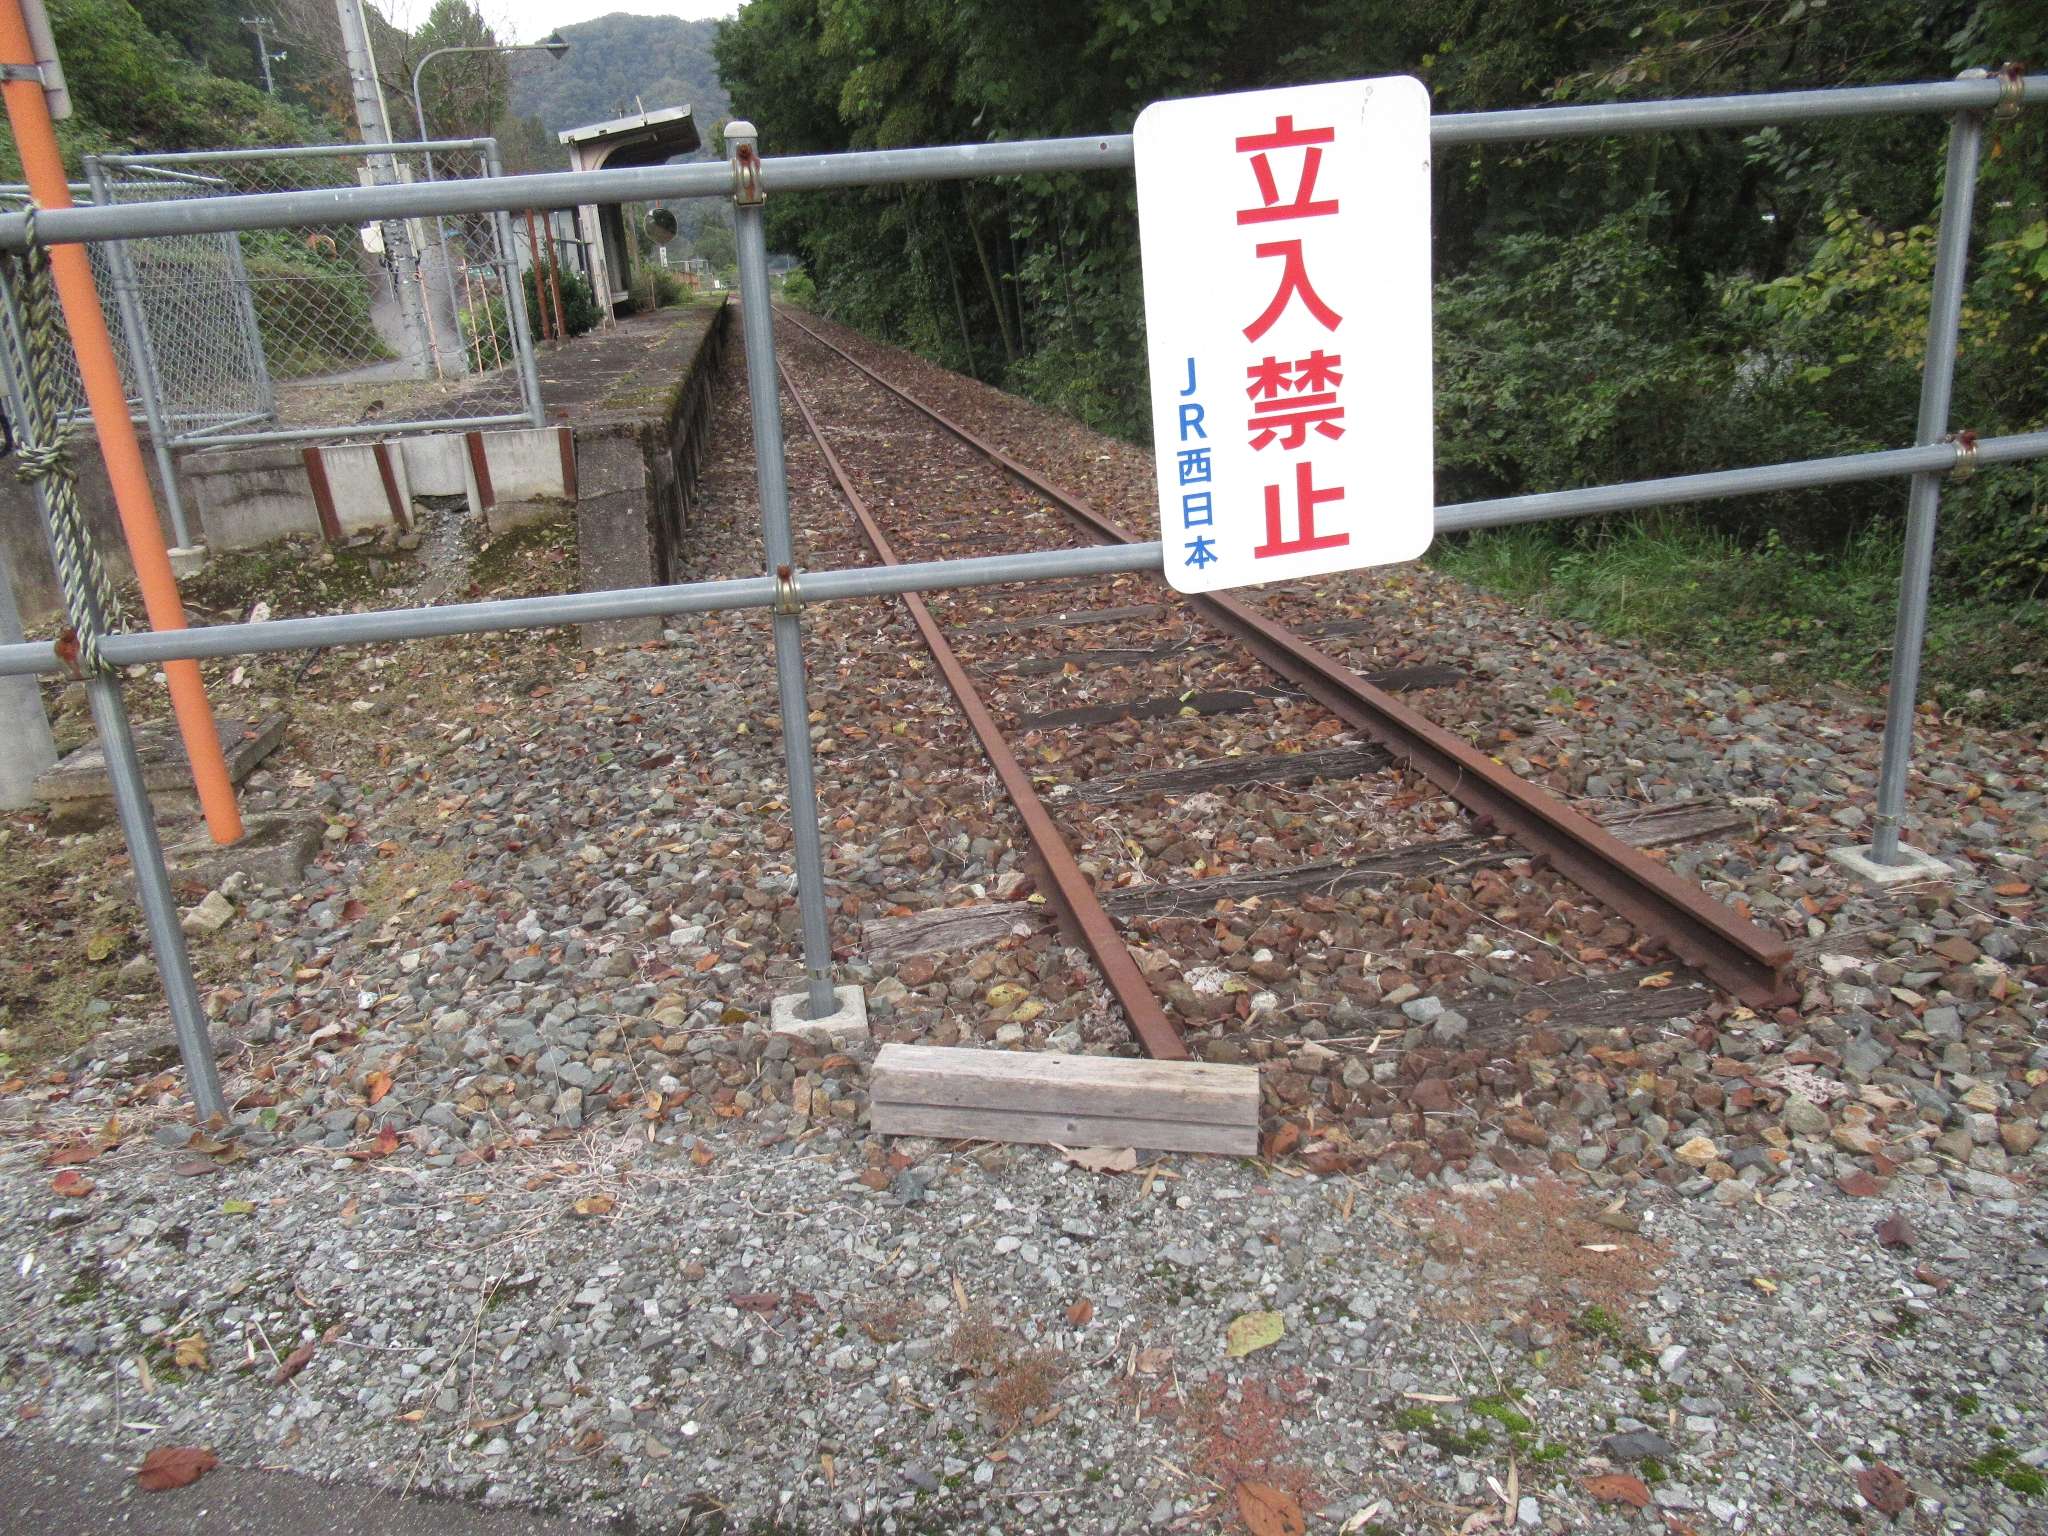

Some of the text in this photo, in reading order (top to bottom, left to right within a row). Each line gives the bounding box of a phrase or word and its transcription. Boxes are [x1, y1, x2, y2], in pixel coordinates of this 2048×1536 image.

[1176, 356, 1219, 570] JR西日本
[1235, 115, 1350, 559] 立入禁止
